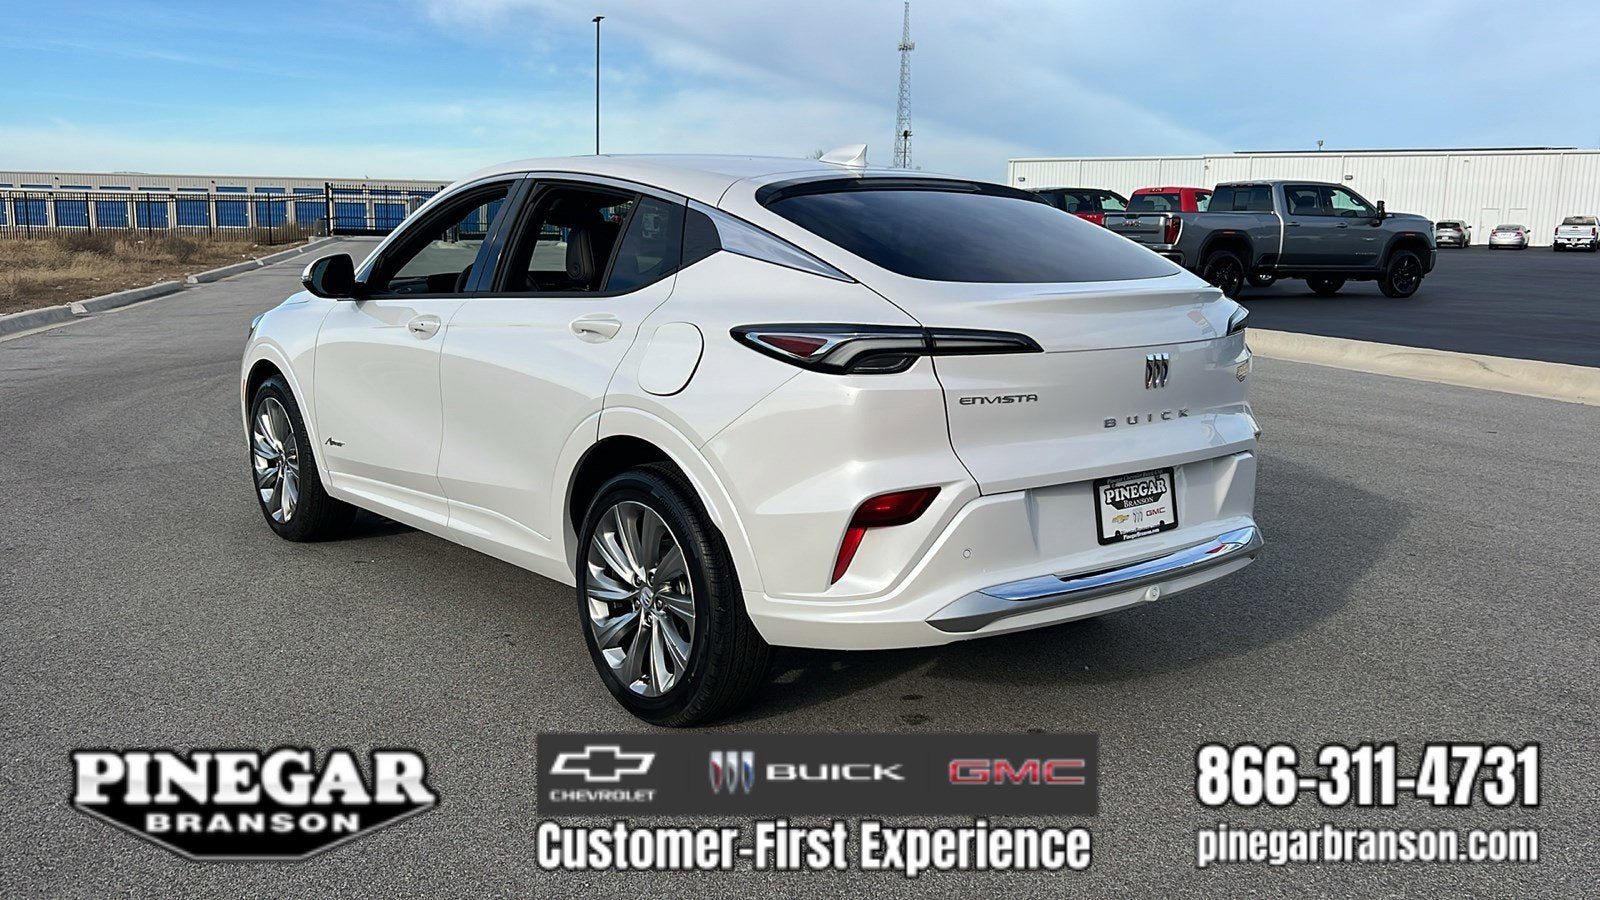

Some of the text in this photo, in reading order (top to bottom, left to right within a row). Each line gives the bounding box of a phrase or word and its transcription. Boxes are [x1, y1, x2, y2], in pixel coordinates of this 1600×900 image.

[959, 393, 1038, 406] ENVISTA
[1104, 408, 1190, 429] BUICK
[1105, 480, 1166, 503] PINEGAR
[1123, 496, 1154, 508] BRANSON
[1145, 507, 1166, 517] GMC
